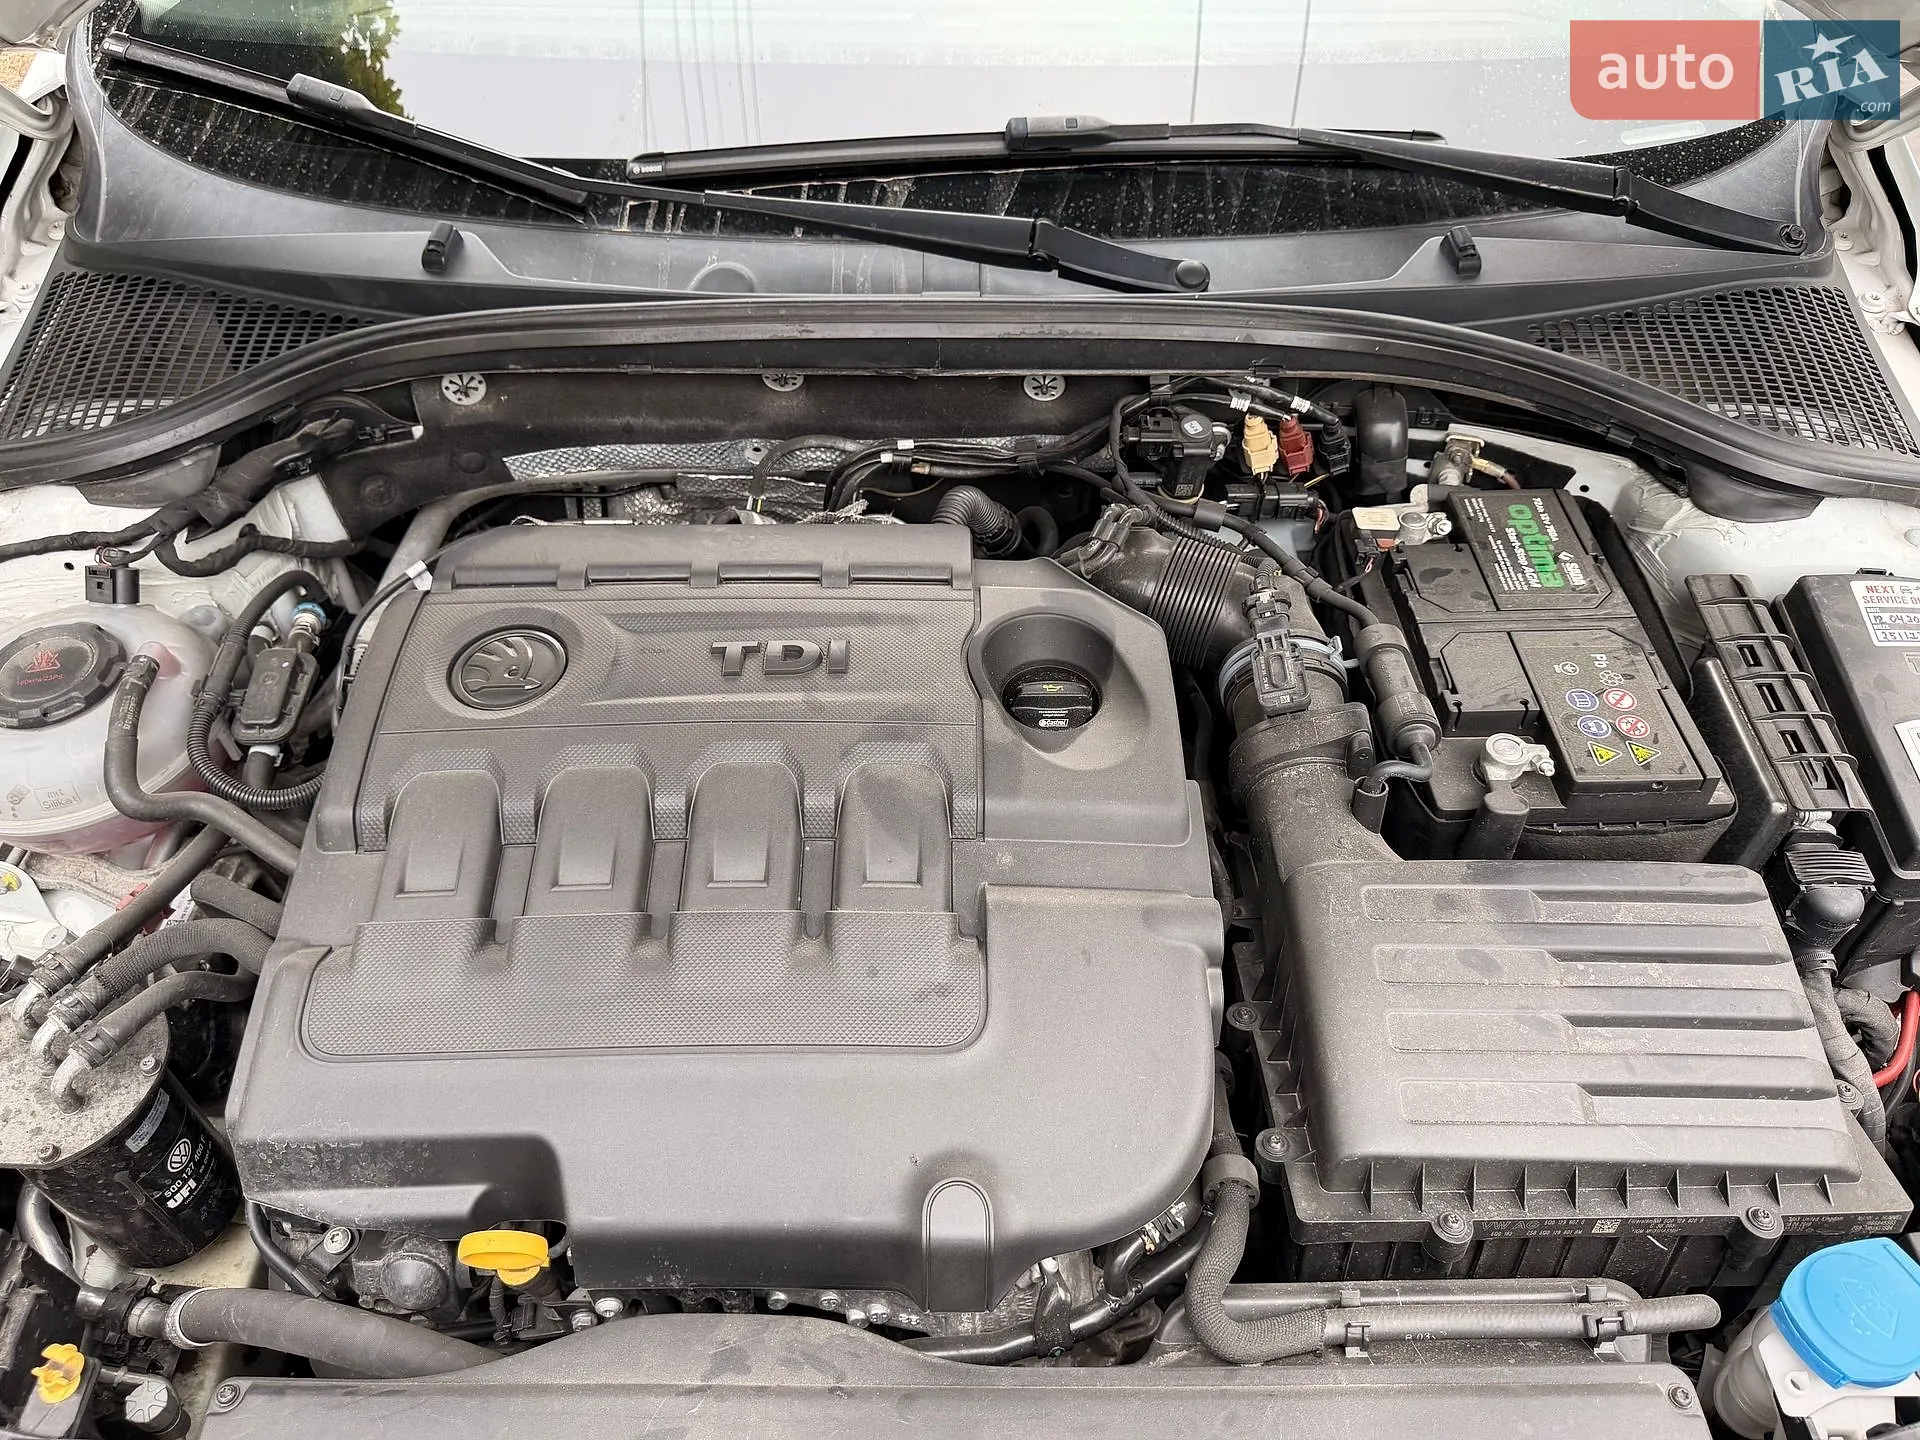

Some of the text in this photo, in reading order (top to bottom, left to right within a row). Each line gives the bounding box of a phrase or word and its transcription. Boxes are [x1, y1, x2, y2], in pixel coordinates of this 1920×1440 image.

[1505, 527, 1528, 566] Start-Stop
[1522, 564, 1542, 588] AGM
[1507, 503, 1564, 588] optima
[1862, 595, 1908, 604] SERVICE
[1865, 585, 1895, 594] NEXT
[711, 640, 848, 676] TDI
[1590, 653, 1610, 668] Pb
[166, 1178, 197, 1209] UFI
